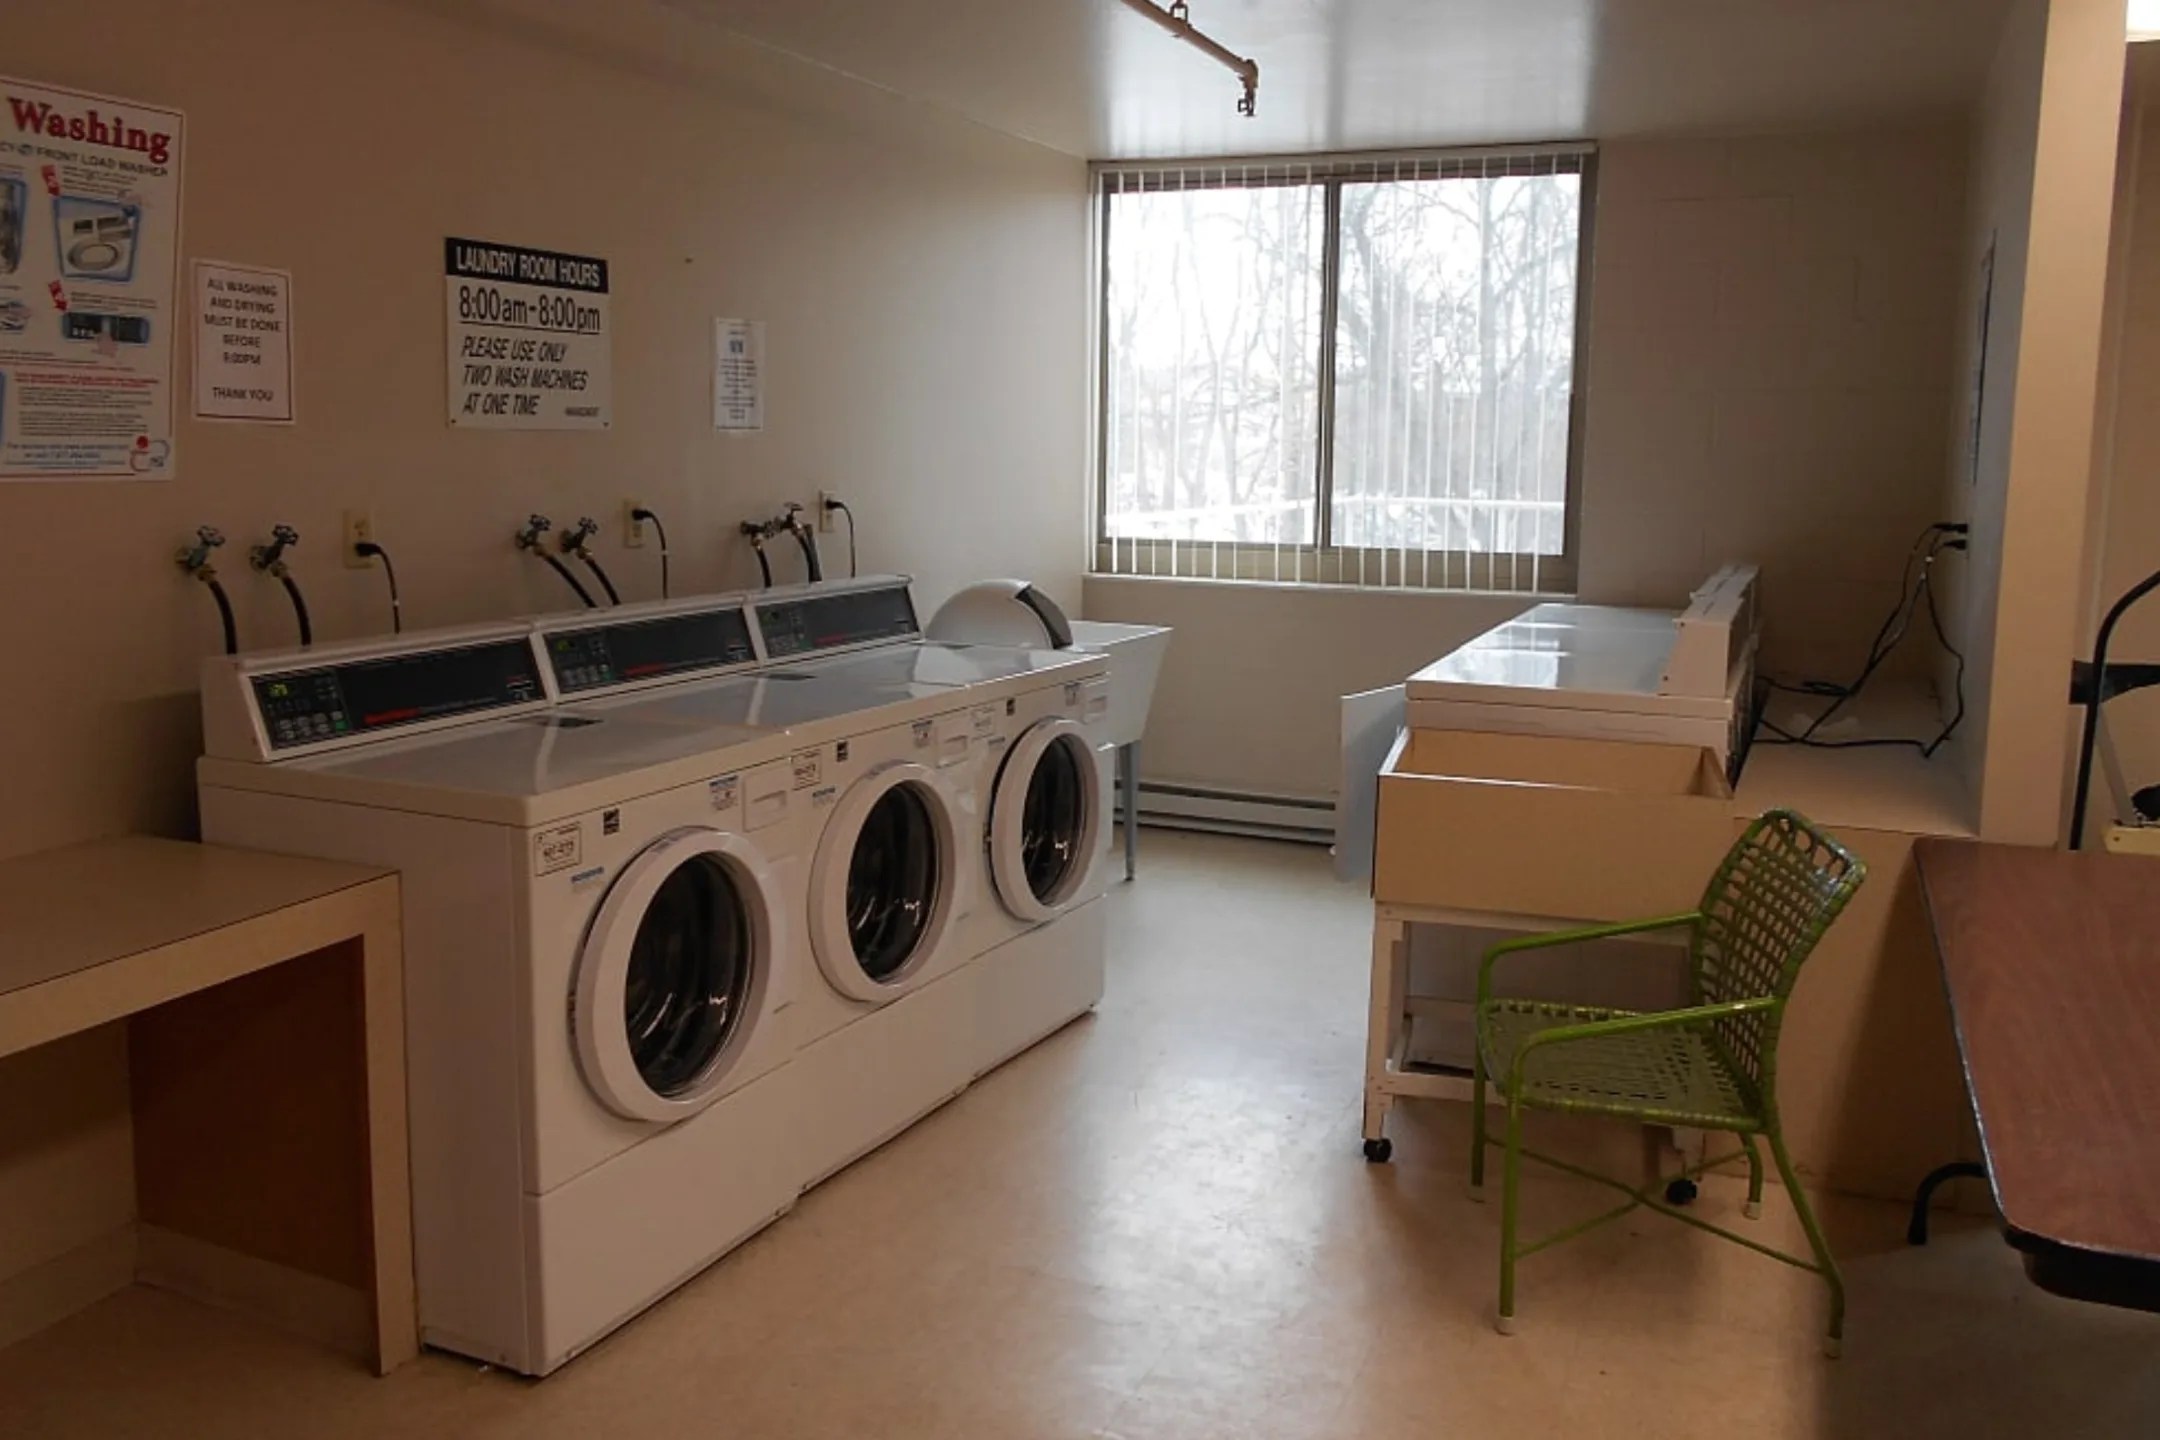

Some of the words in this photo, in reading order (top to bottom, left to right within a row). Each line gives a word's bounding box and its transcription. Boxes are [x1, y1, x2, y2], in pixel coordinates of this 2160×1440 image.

[7, 97, 171, 164] Washing
[81, 154, 117, 169] LOAD
[456, 246, 516, 277] LAUNDRY
[519, 255, 556, 281] ROOM
[559, 260, 600, 287] HOURS
[226, 282, 278, 297] WASHING
[210, 296, 232, 309] AND
[234, 299, 275, 314] DRYING
[204, 314, 233, 327] MUST
[235, 317, 248, 329] BE
[250, 319, 282, 332] DONE
[223, 334, 261, 348] BEFORE
[461, 335, 510, 360] PLEASE
[511, 339, 536, 362] USE
[538, 341, 568, 363] ONLY
[463, 364, 492, 387] TWO
[495, 366, 530, 388] WASH
[531, 368, 588, 391] MACHINES
[212, 386, 247, 400] THANK
[249, 389, 274, 402] YOU
[462, 393, 481, 414] AT
[482, 393, 510, 415] ONE
[513, 395, 541, 416] TIME
